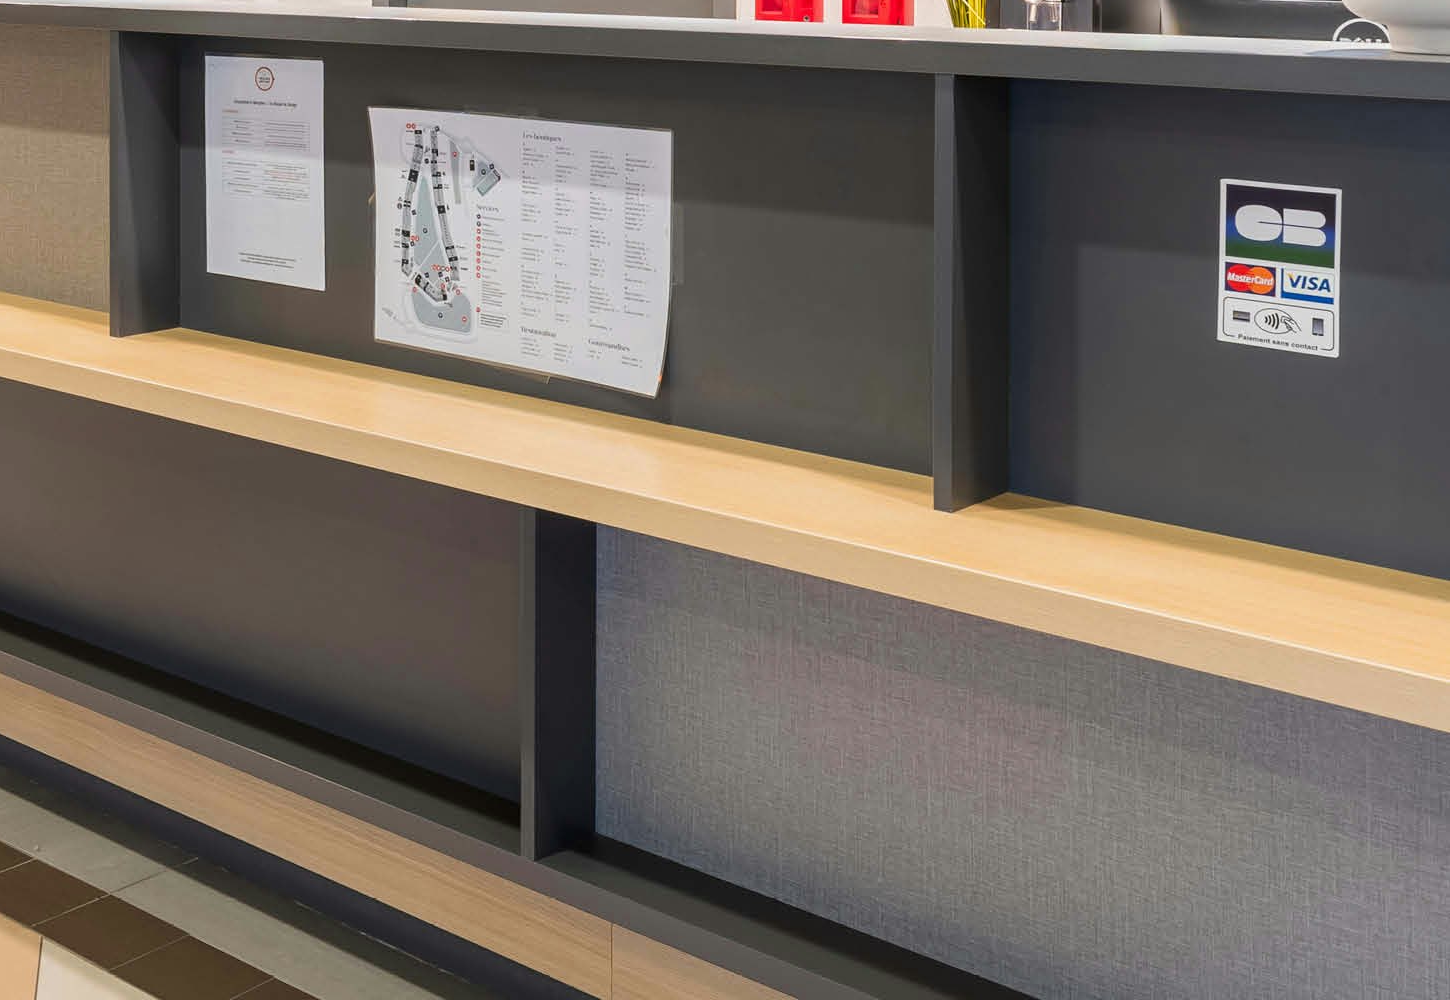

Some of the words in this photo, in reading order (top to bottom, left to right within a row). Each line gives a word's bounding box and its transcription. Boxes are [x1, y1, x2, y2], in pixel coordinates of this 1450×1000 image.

[1234, 204, 1327, 247] CB
[1226, 271, 1274, 286] MasterCard
[1287, 272, 1331, 293] VISA
[1237, 334, 1271, 345] Paiement
[1272, 339, 1290, 348] sans
[1291, 341, 1319, 351] contact
